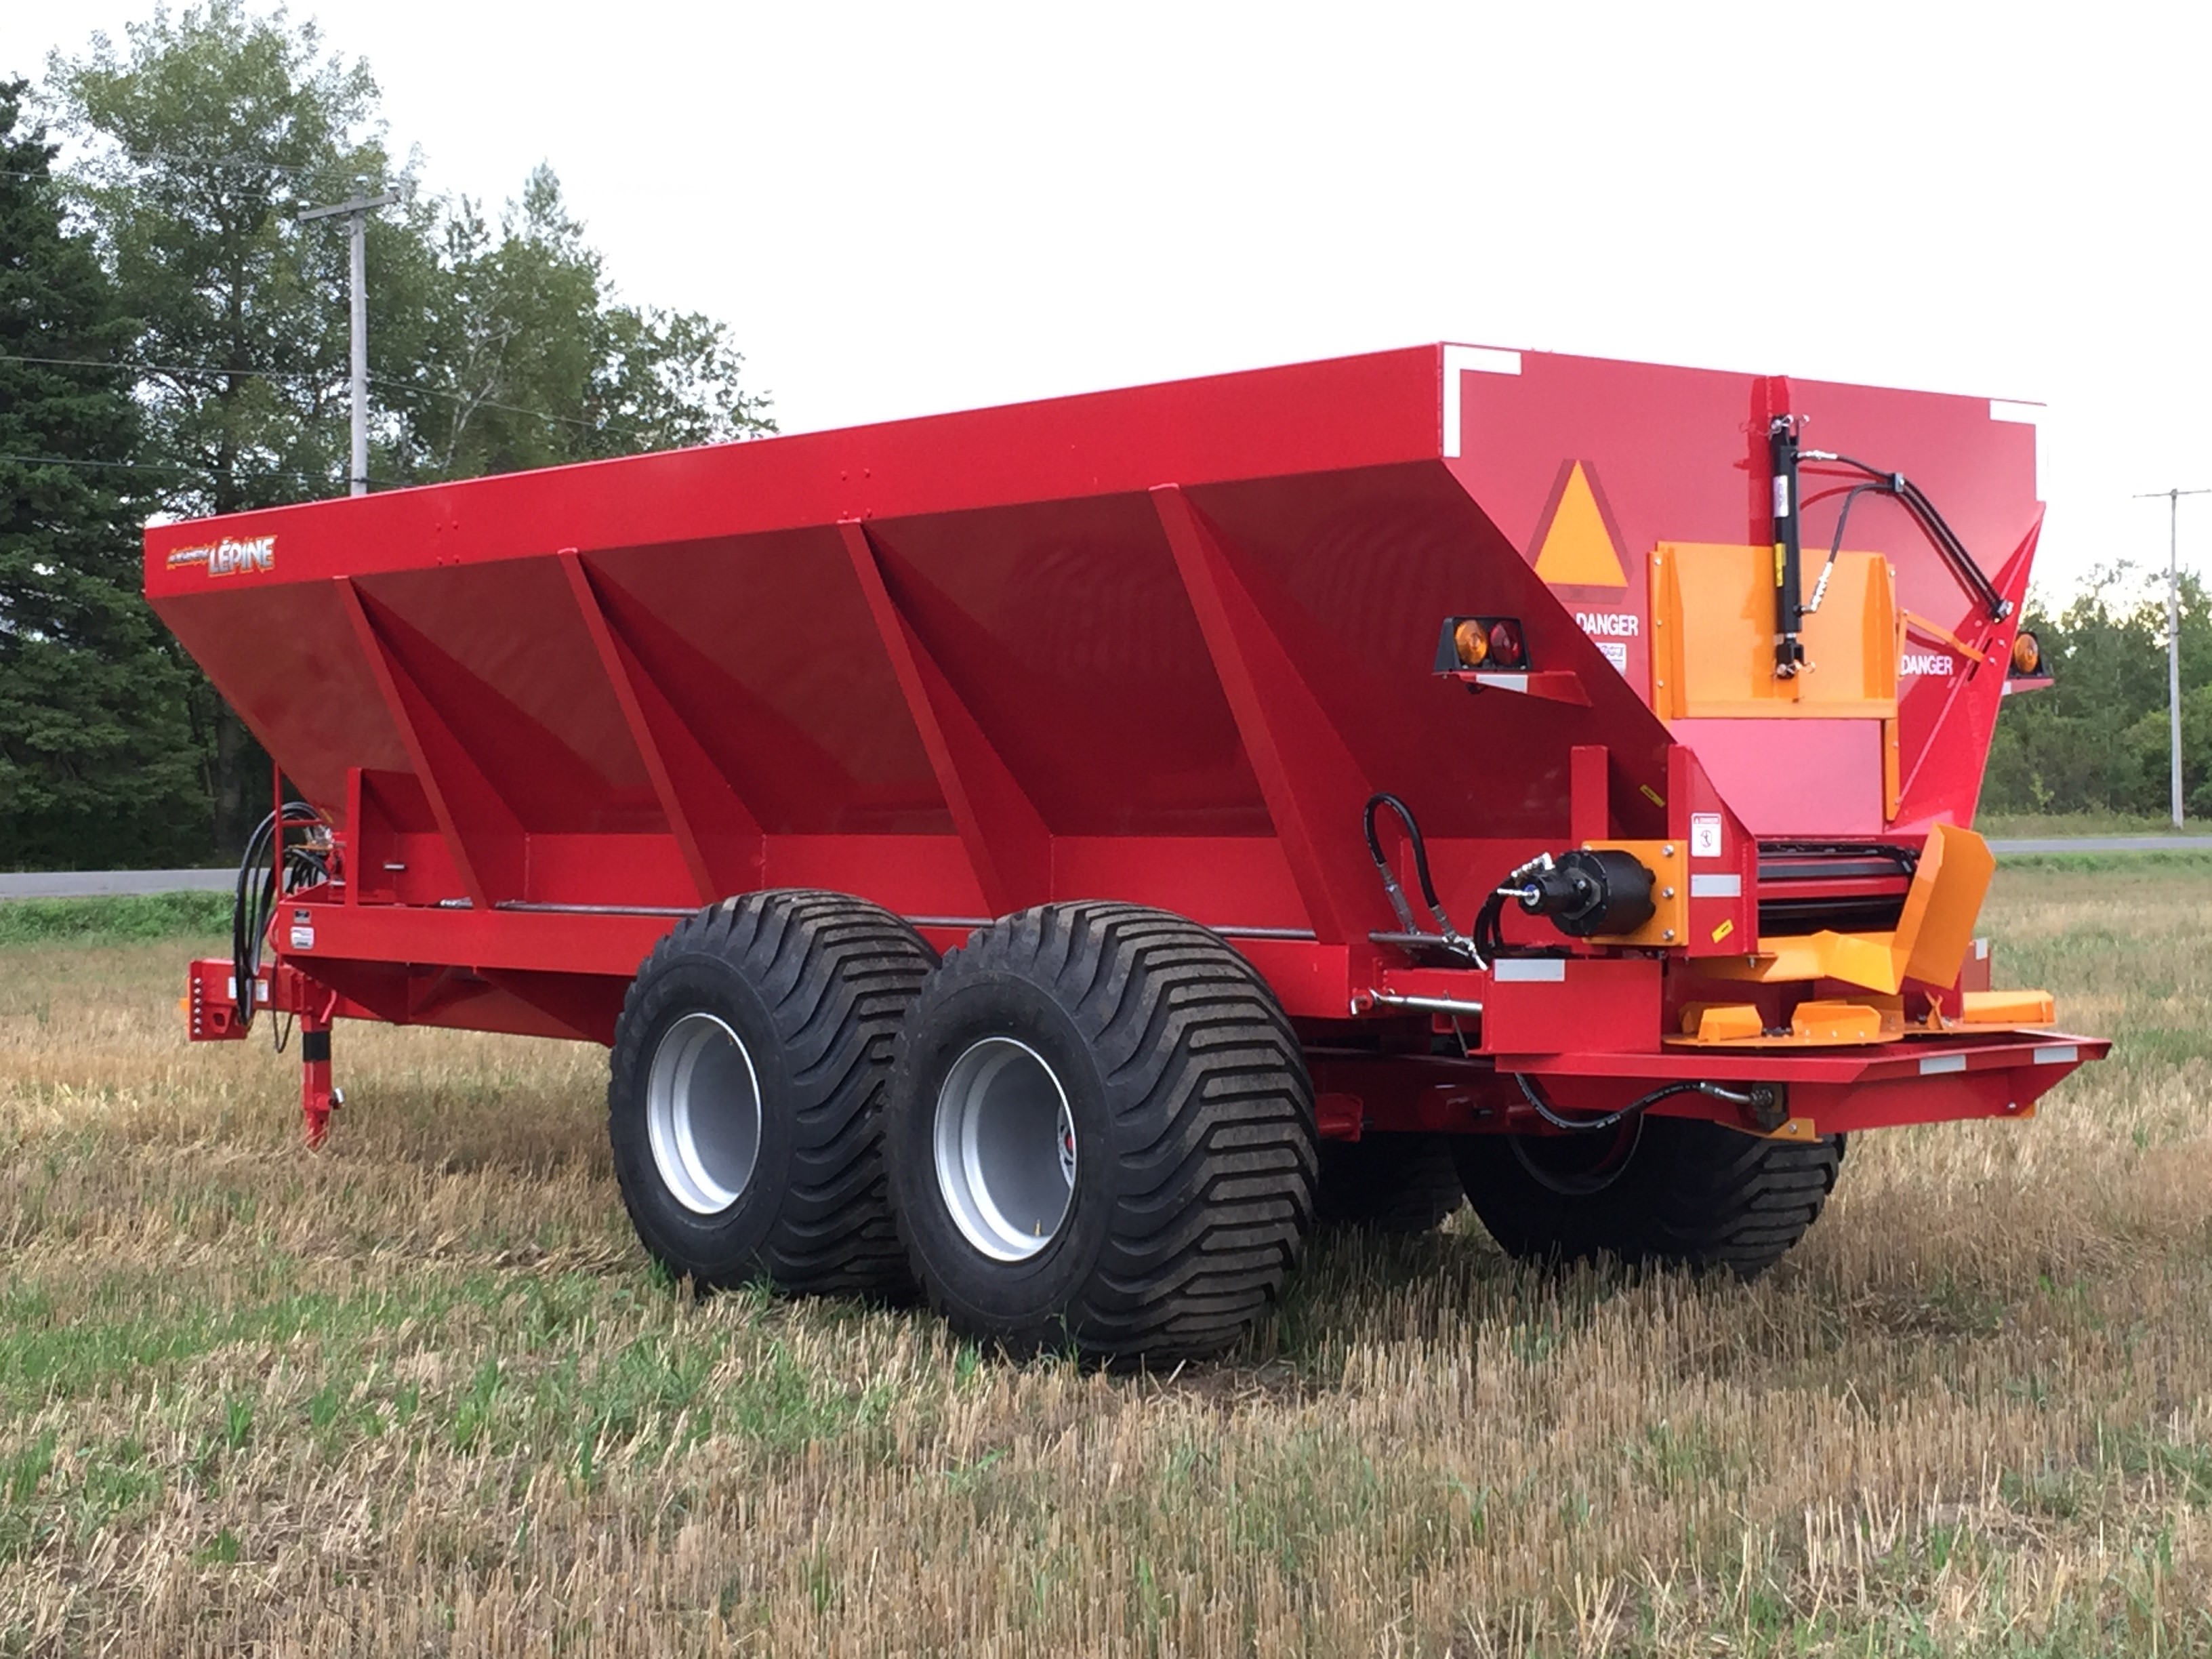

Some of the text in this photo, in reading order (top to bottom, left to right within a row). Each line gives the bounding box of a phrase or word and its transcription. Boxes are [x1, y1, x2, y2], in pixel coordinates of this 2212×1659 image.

[208, 536, 276, 575] LÉPINE
[1576, 613, 1639, 636] DANGER
[1901, 655, 1953, 675] DANGER
